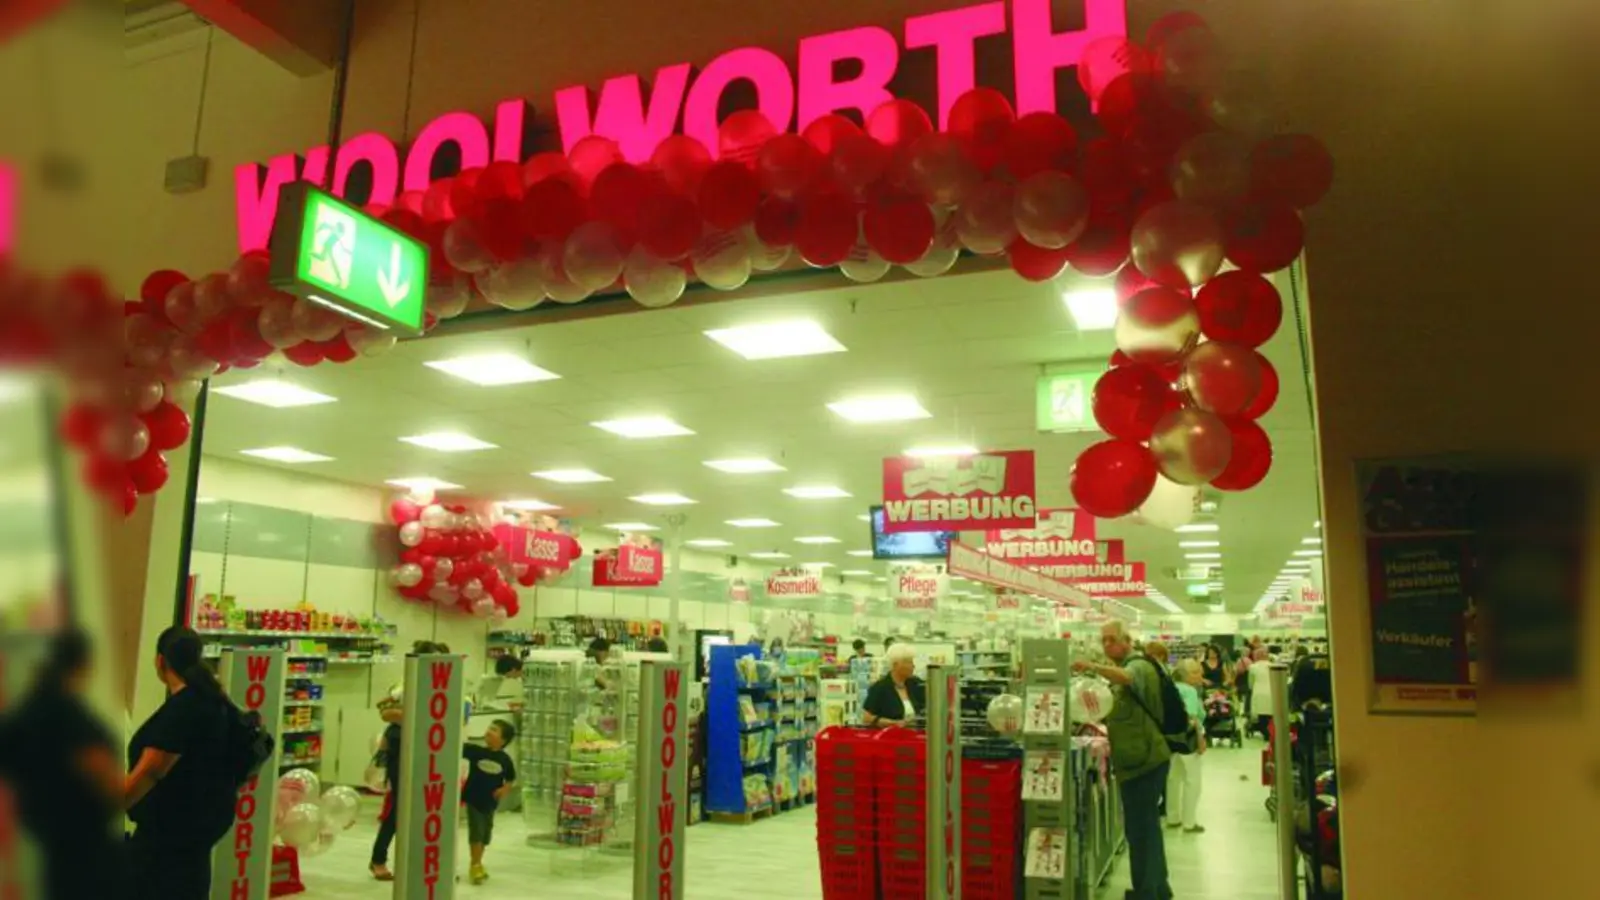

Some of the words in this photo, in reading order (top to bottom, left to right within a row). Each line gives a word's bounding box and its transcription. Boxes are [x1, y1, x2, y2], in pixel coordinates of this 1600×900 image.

[884, 495, 1034, 522] WERBUNG
[987, 539, 1094, 560] WERBUNG
[767, 578, 819, 595] Kosmetik
[900, 576, 937, 596] Pflege
